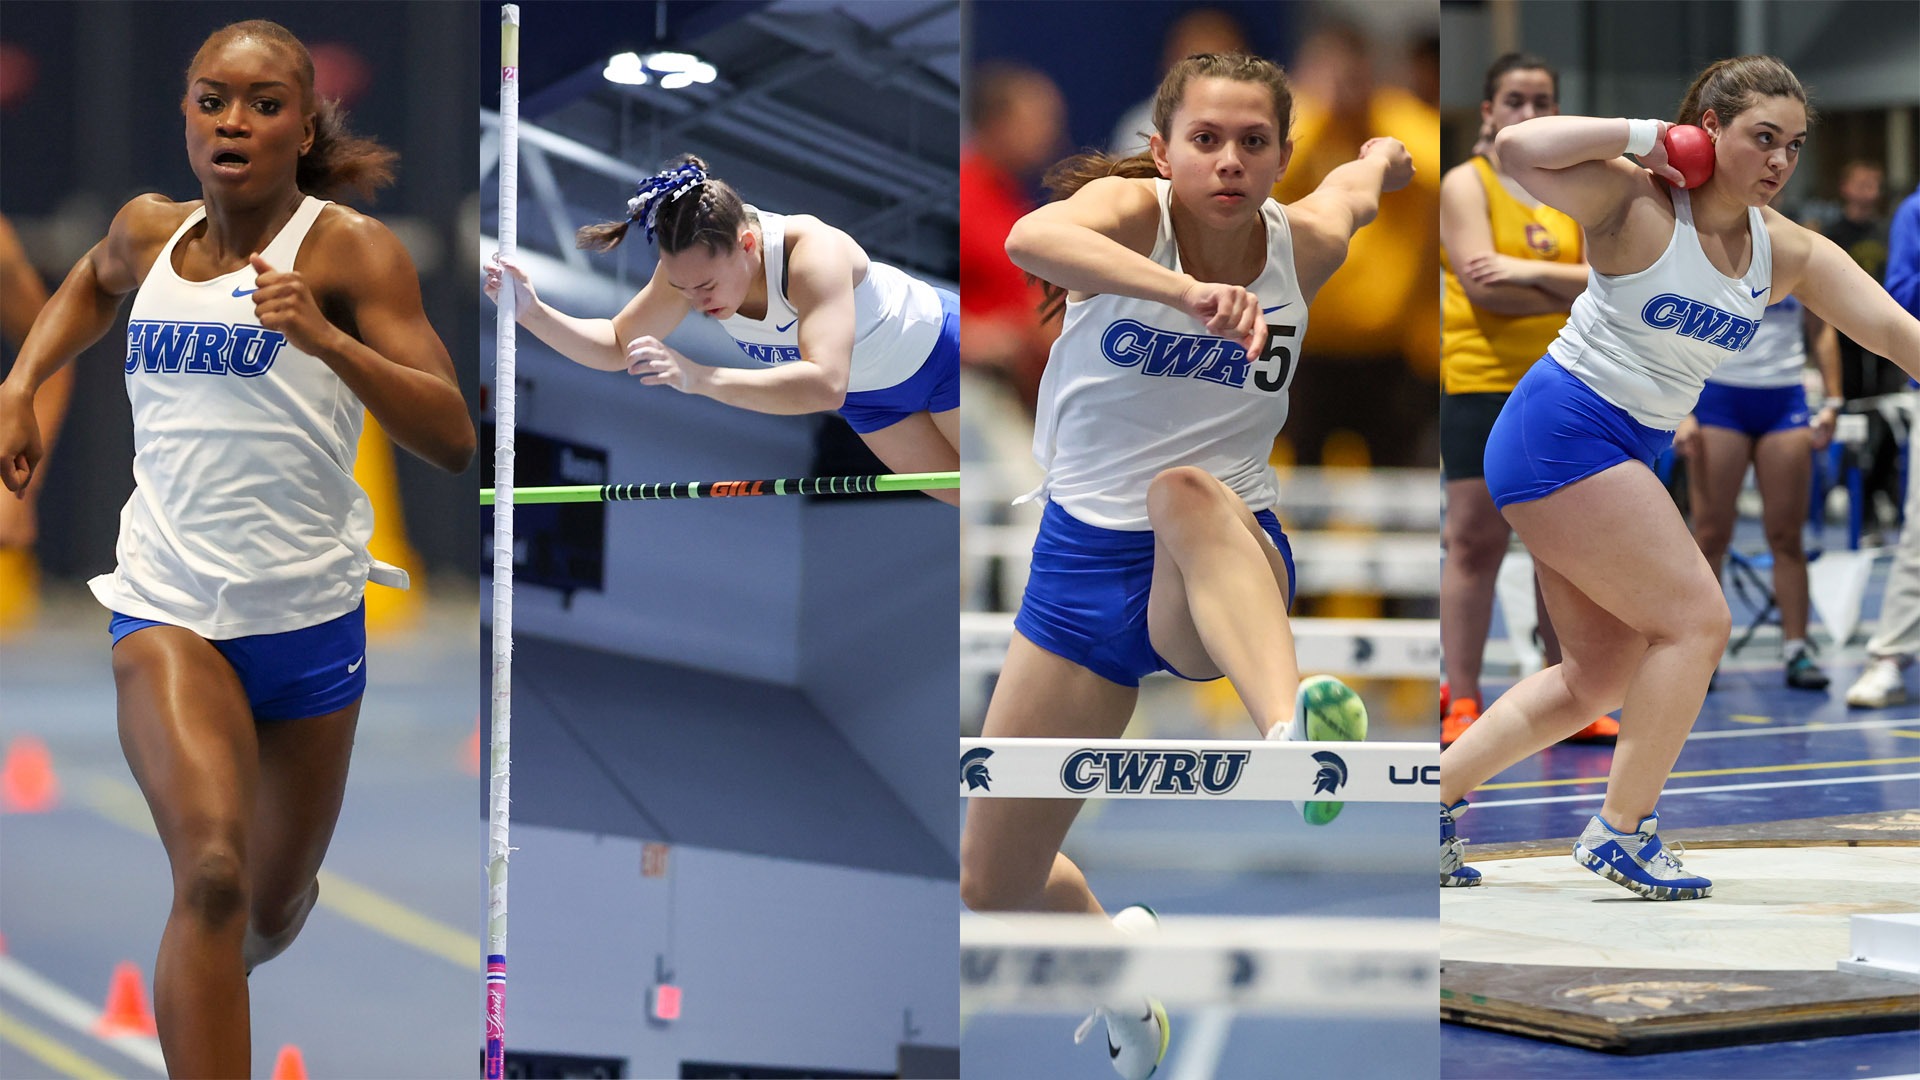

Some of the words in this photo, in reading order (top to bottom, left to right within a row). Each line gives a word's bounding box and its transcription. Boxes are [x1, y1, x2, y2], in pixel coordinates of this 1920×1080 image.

[125, 319, 287, 377] CWRU
[1641, 293, 1762, 352] CWR
[1101, 318, 1252, 389] CWR
[1254, 324, 1296, 393] 5
[710, 480, 764, 498] GILL
[1060, 748, 1252, 796] CWRU
[486, 988, 505, 1038] Spirit
